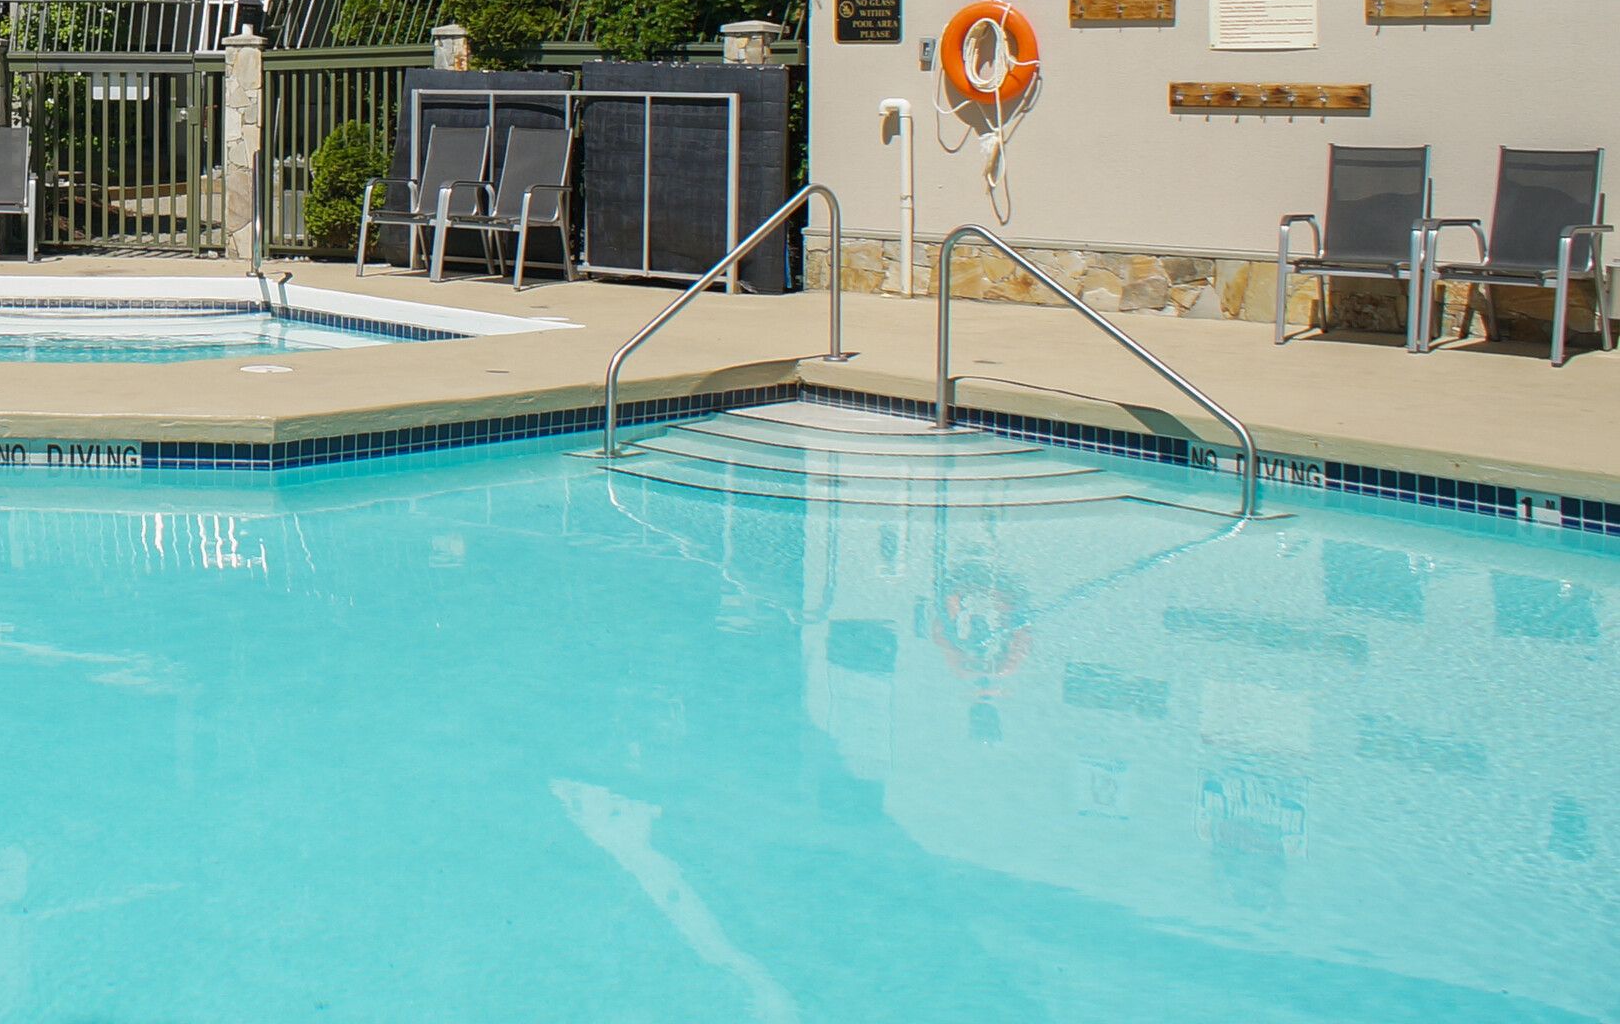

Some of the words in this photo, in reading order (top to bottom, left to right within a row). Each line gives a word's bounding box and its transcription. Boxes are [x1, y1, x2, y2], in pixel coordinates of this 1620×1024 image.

[859, 9, 891, 17] WITHIN
[852, 20, 875, 28] POOL
[877, 19, 898, 27] AREA
[860, 30, 891, 38] PLEASE
[46, 443, 138, 466] DIVING
[1191, 446, 1217, 467] NO
[1521, 496, 1533, 521] 1
